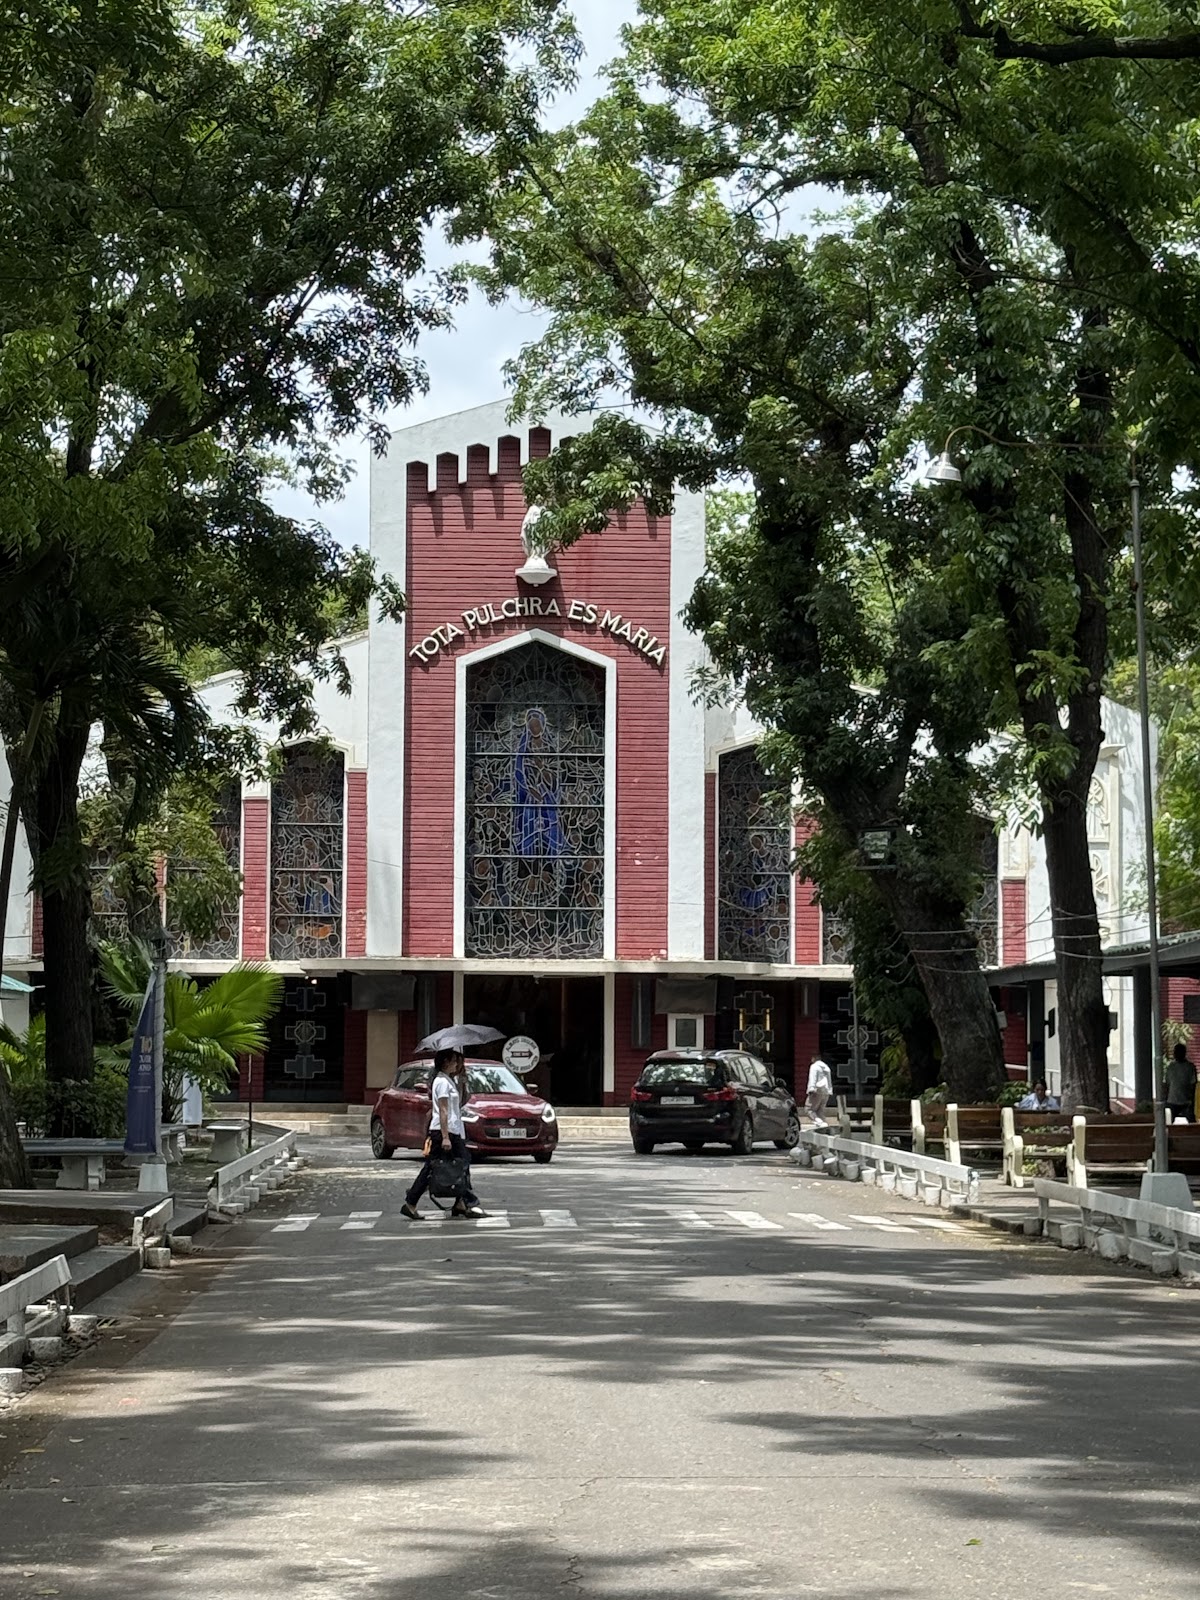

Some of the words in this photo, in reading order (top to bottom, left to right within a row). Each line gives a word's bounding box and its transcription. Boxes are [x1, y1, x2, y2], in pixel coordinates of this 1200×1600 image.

[409, 622, 464, 663] TOTA
[462, 597, 561, 630] PULCHRA
[567, 600, 599, 624] ES
[599, 610, 667, 667] MARIA
